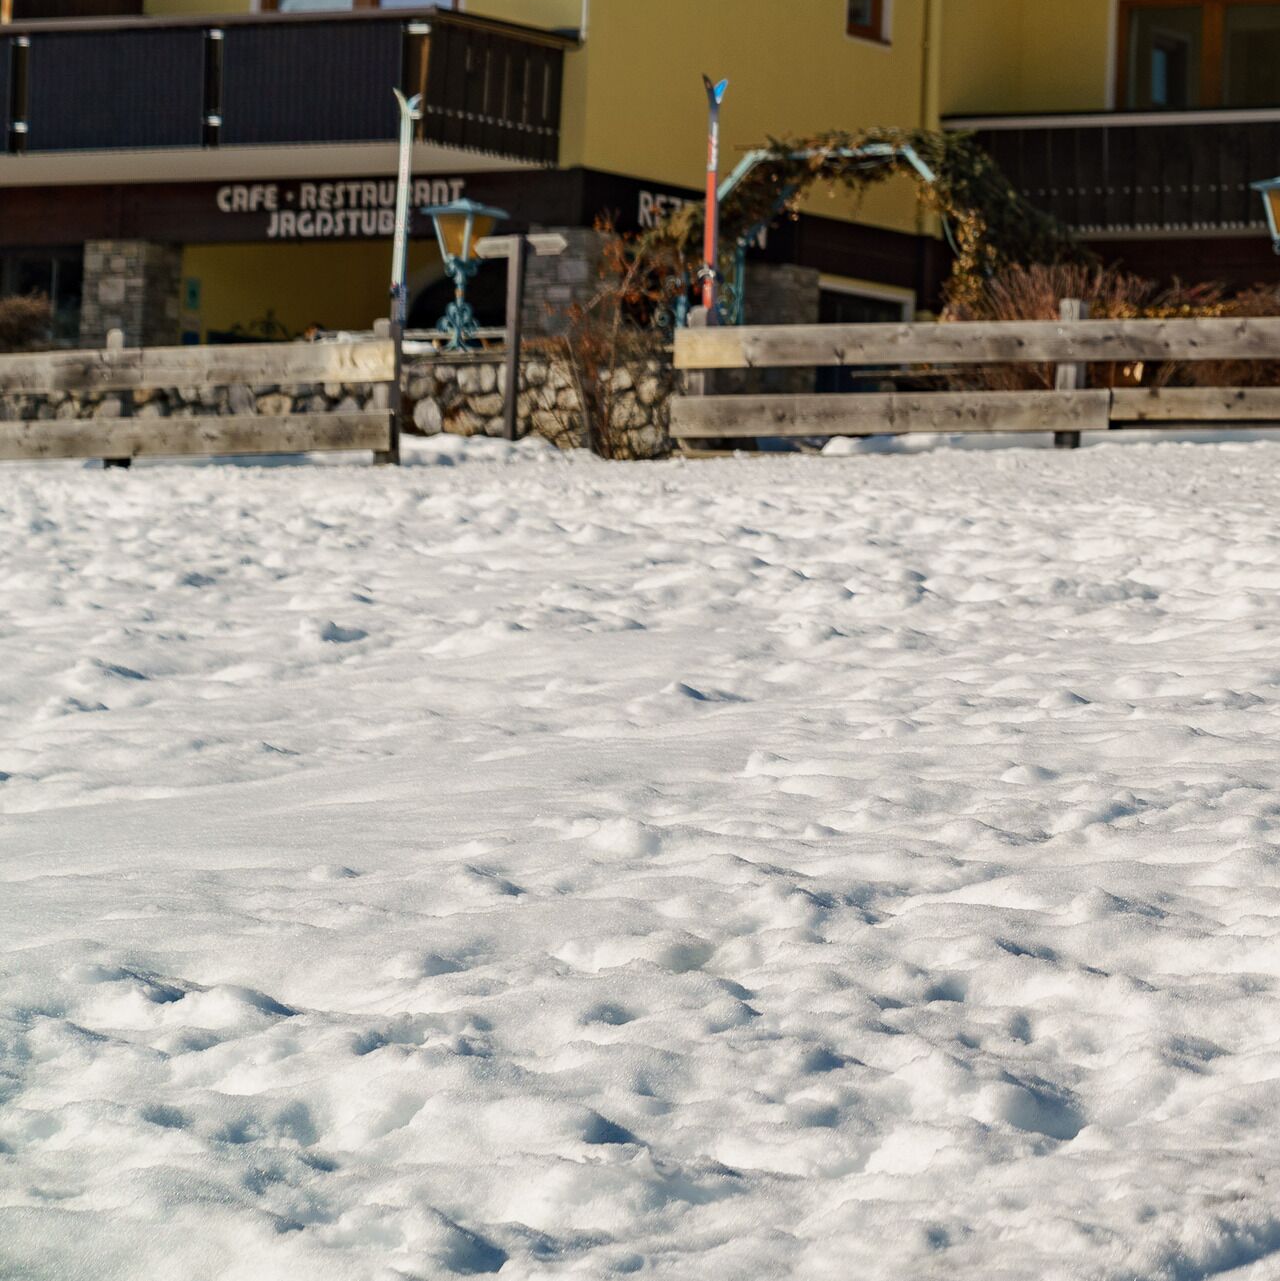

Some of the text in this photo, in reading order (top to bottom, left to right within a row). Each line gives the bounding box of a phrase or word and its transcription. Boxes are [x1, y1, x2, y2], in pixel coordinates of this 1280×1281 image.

[216, 178, 465, 212] CAFE RESTAUANT
[267, 207, 411, 238] JAGDSTUB
